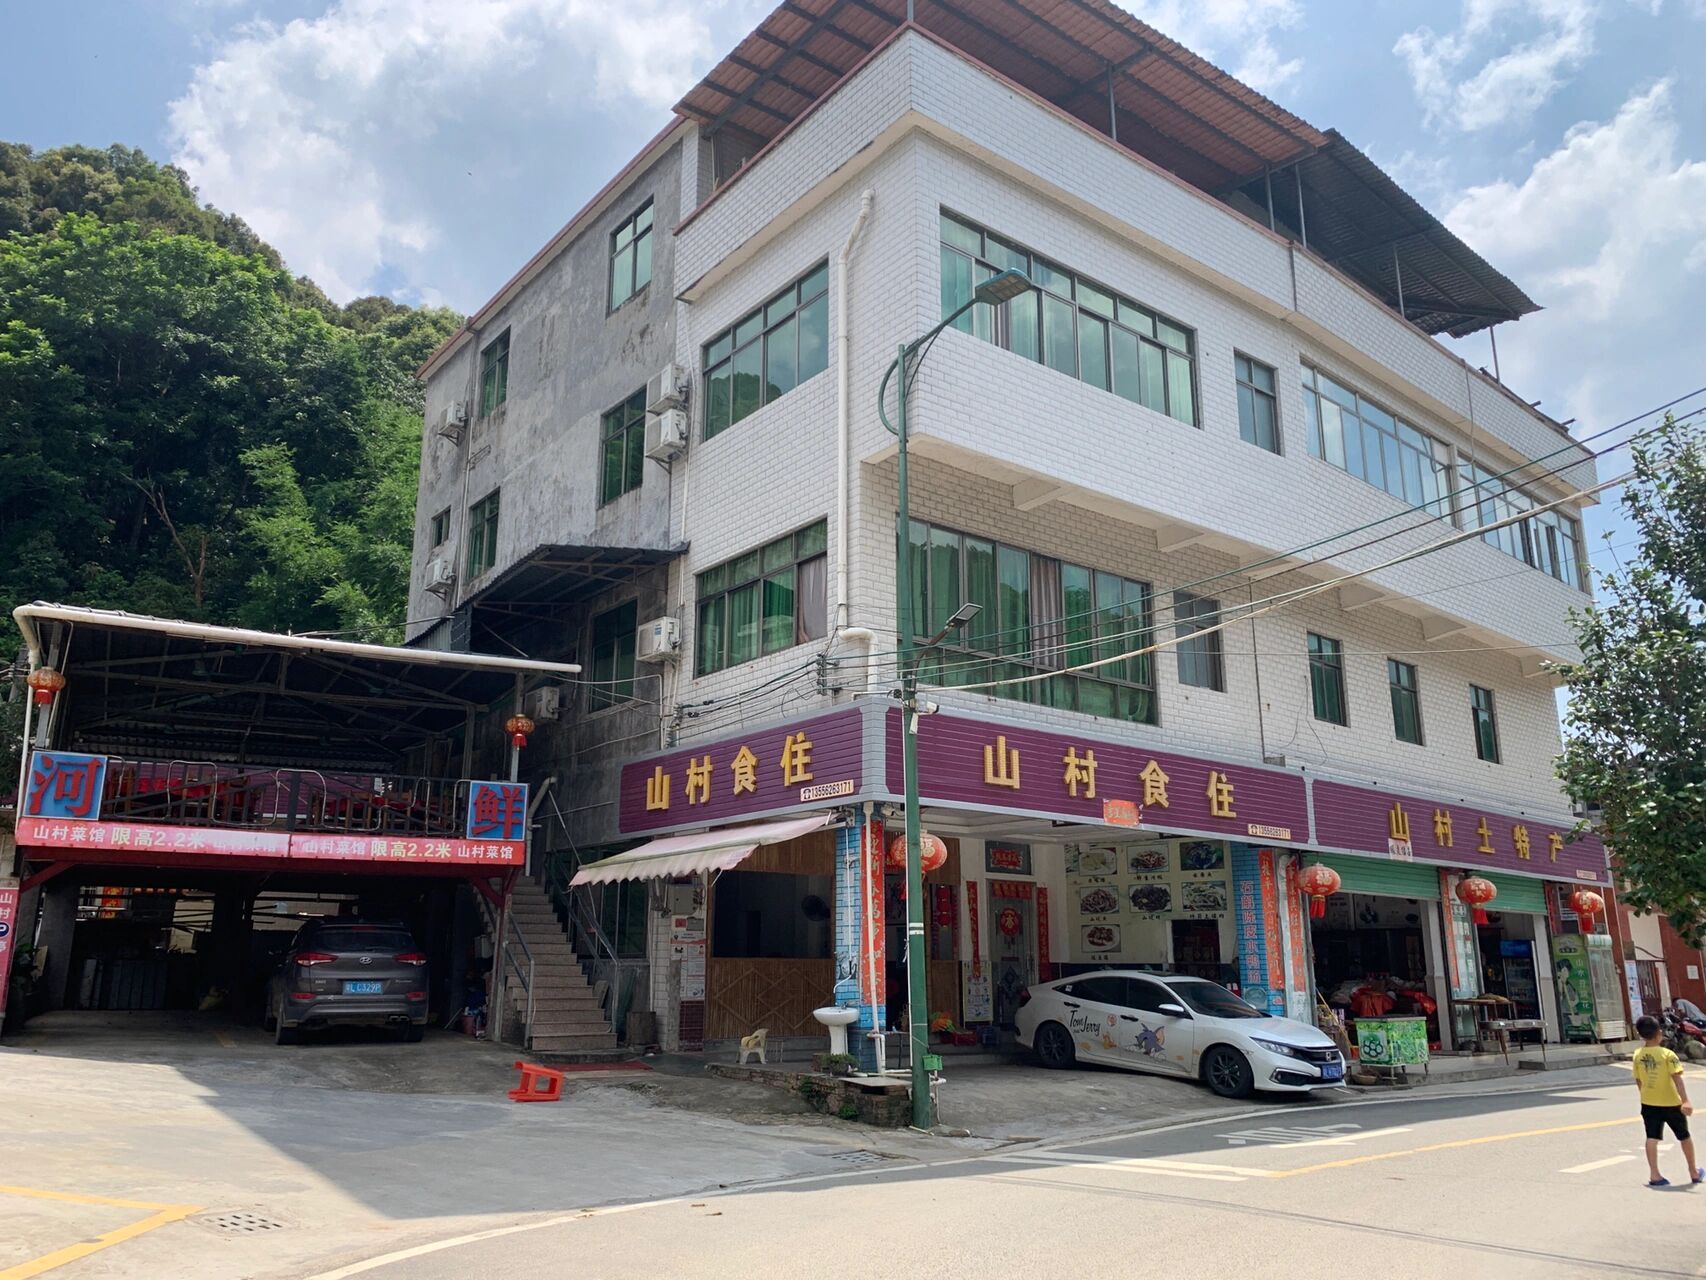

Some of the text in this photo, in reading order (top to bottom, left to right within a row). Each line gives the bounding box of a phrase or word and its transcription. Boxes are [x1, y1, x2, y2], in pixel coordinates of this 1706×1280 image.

[29, 755, 521, 839] 河 鲜
[646, 731, 813, 811] 山村食住
[984, 735, 1237, 818] 山村食住
[33, 825, 104, 843] 山村菜馆
[111, 826, 205, 849] 限高2.2米
[303, 840, 513, 860] 山村菜馆 限高2.2米 山村菜馆
[1389, 802, 1563, 862] 山村土特产
[1080, 1016, 1101, 1037] Jerry
